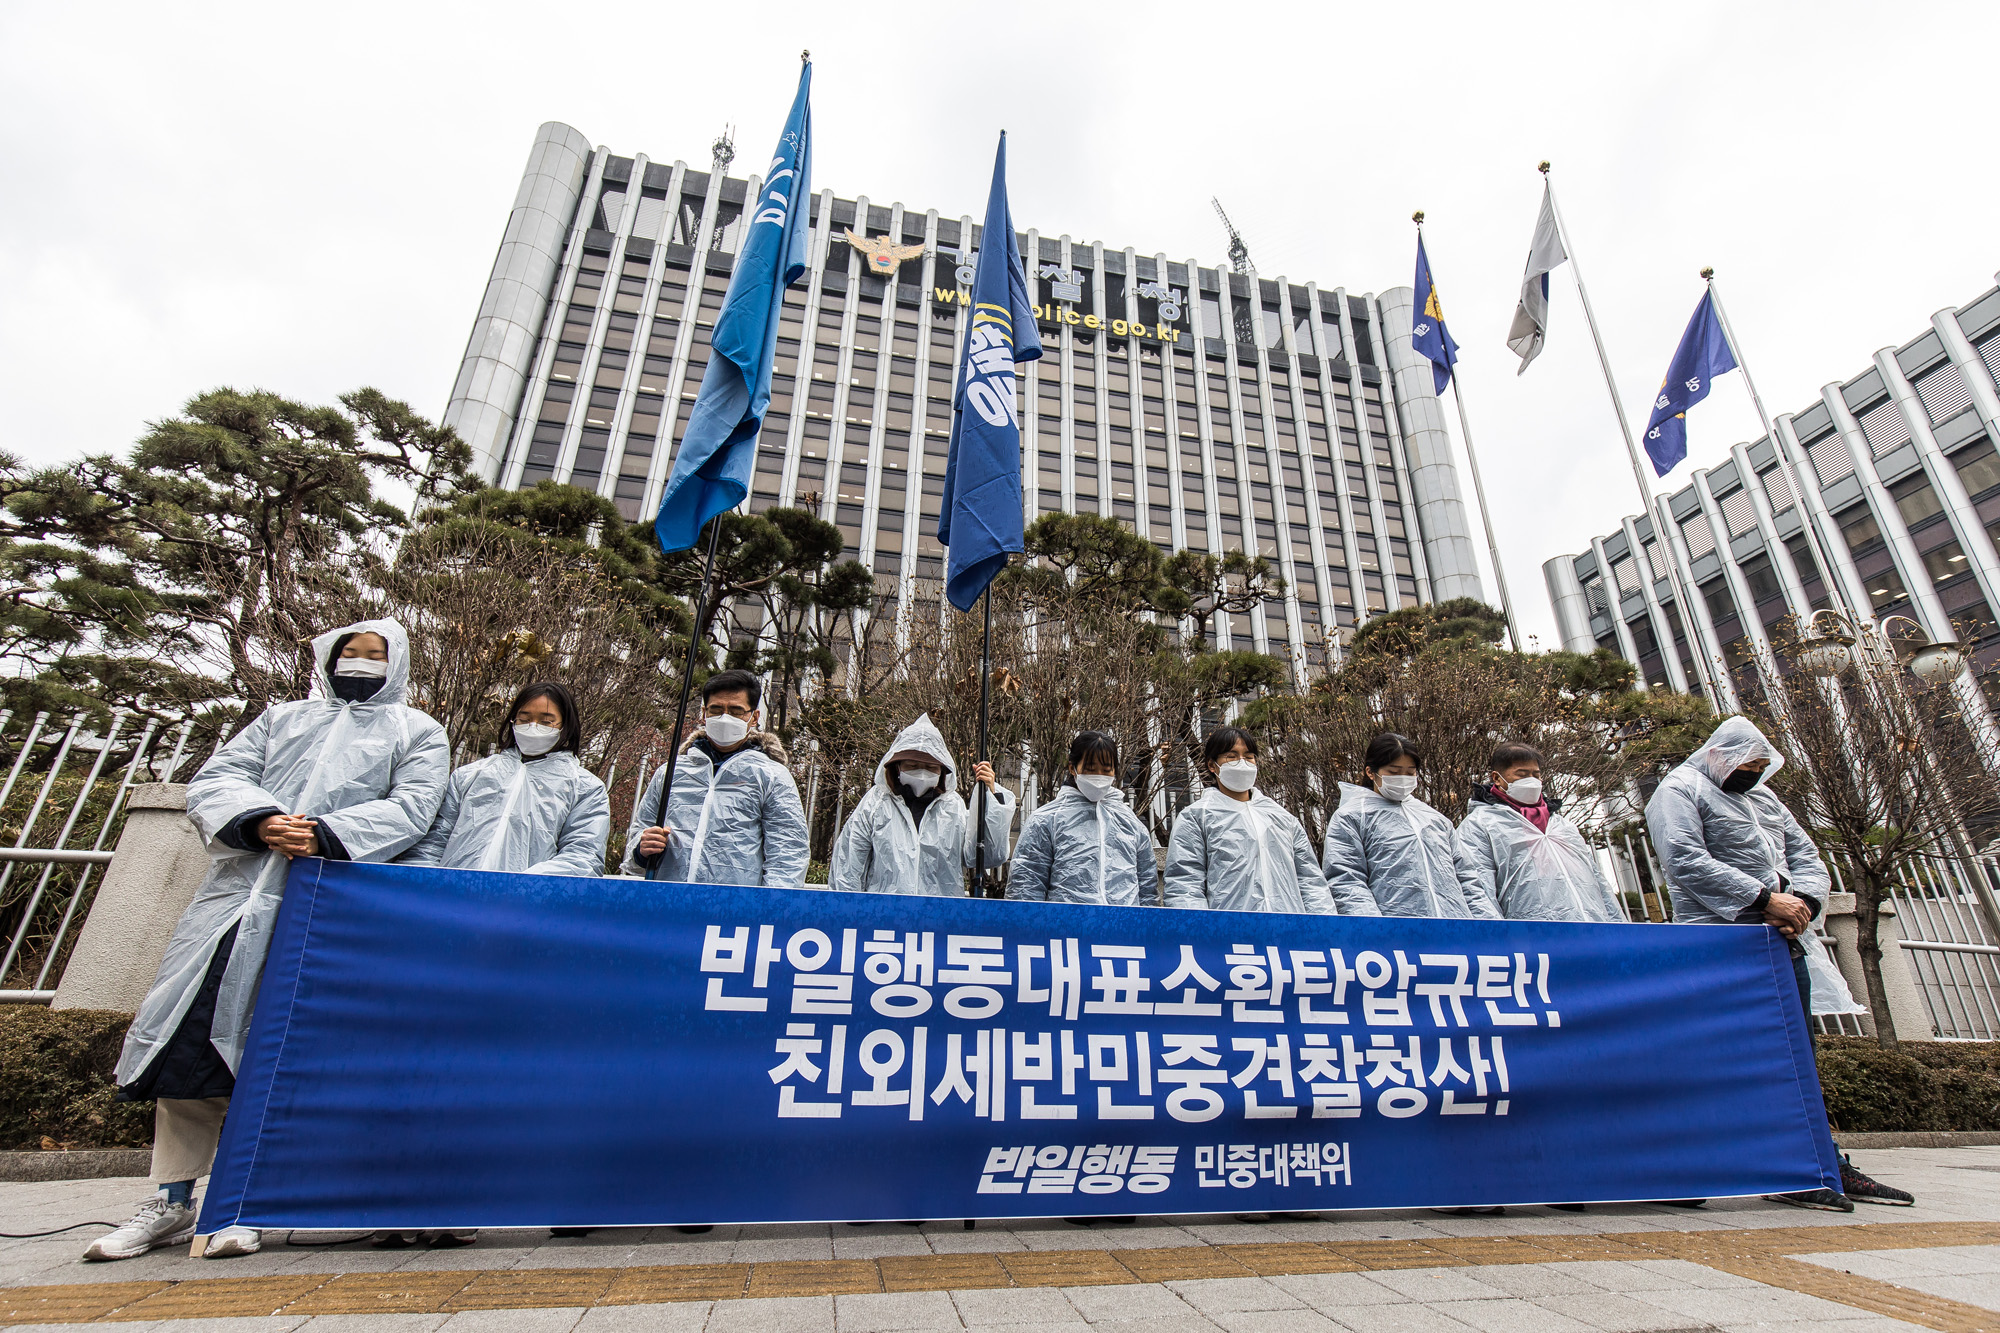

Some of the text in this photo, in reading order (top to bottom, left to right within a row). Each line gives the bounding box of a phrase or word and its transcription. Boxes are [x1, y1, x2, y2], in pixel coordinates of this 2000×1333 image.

[935, 287, 1181, 343] wwolice.go.kr
[700, 924, 1562, 1029] 반일행동대표소환탄압규탄!
[767, 1022, 1511, 1123] 친외세반민중견찰청산!
[976, 1142, 1352, 1194] 반일행동 민중대책위
